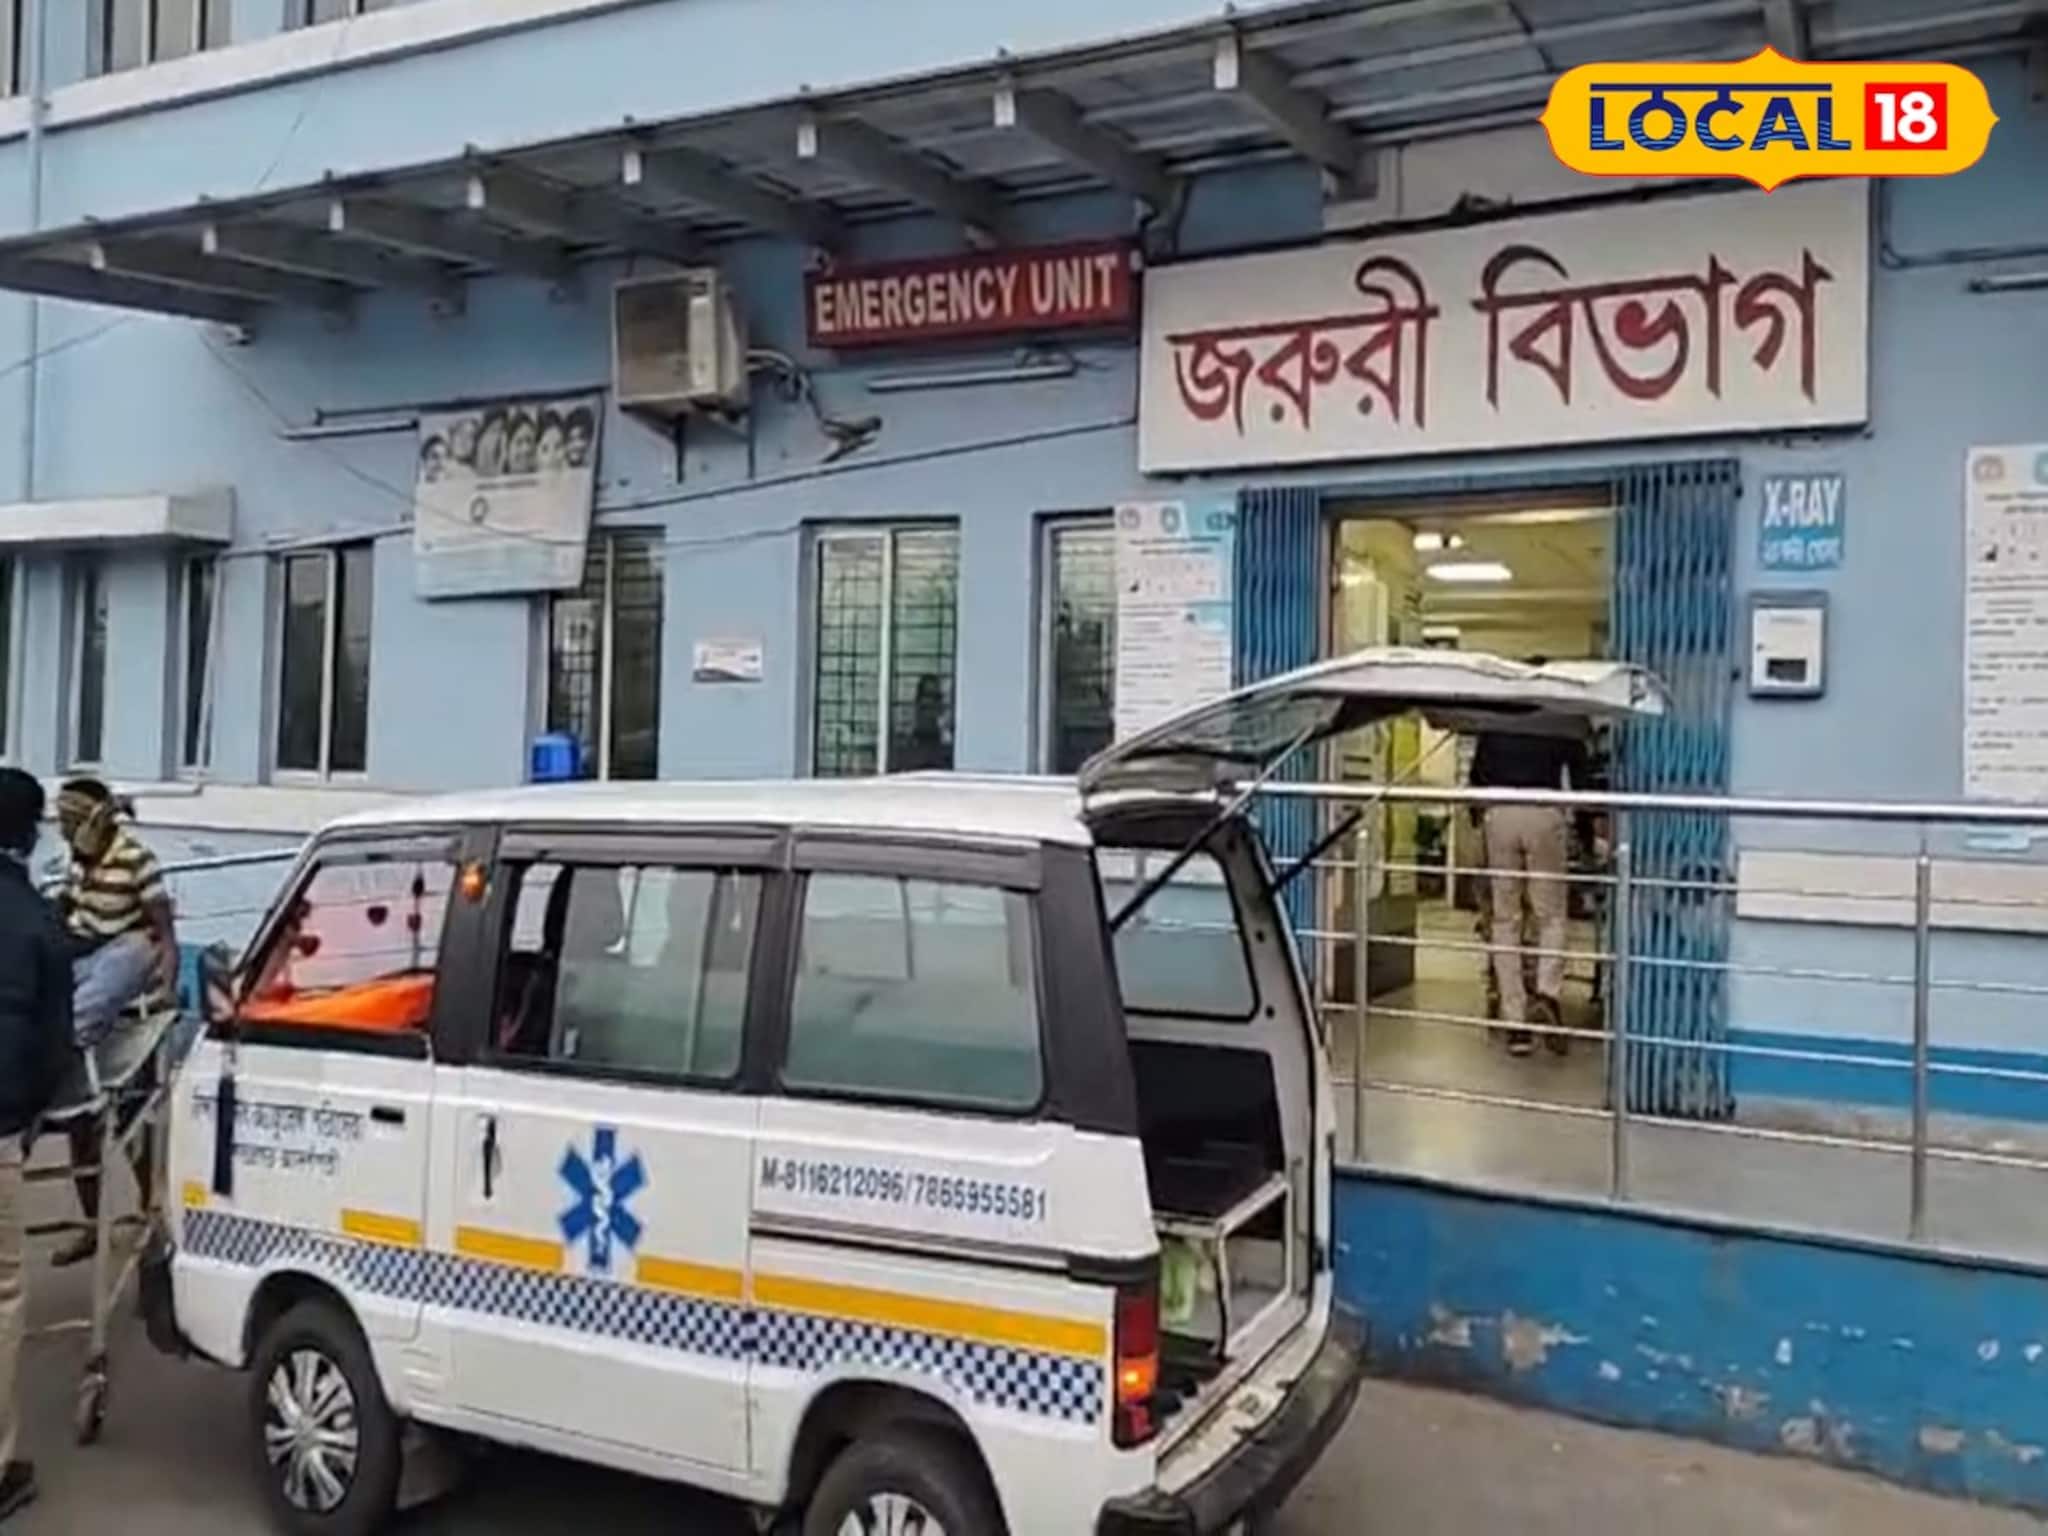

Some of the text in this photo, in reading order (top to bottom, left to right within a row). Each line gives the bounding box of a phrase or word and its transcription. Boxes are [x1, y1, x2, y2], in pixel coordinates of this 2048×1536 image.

[814, 254, 1118, 333] EMERGENCY UNIT
[1166, 245, 1833, 437] জরুরী বিভাগ
[1763, 478, 1841, 527] X-RAY
